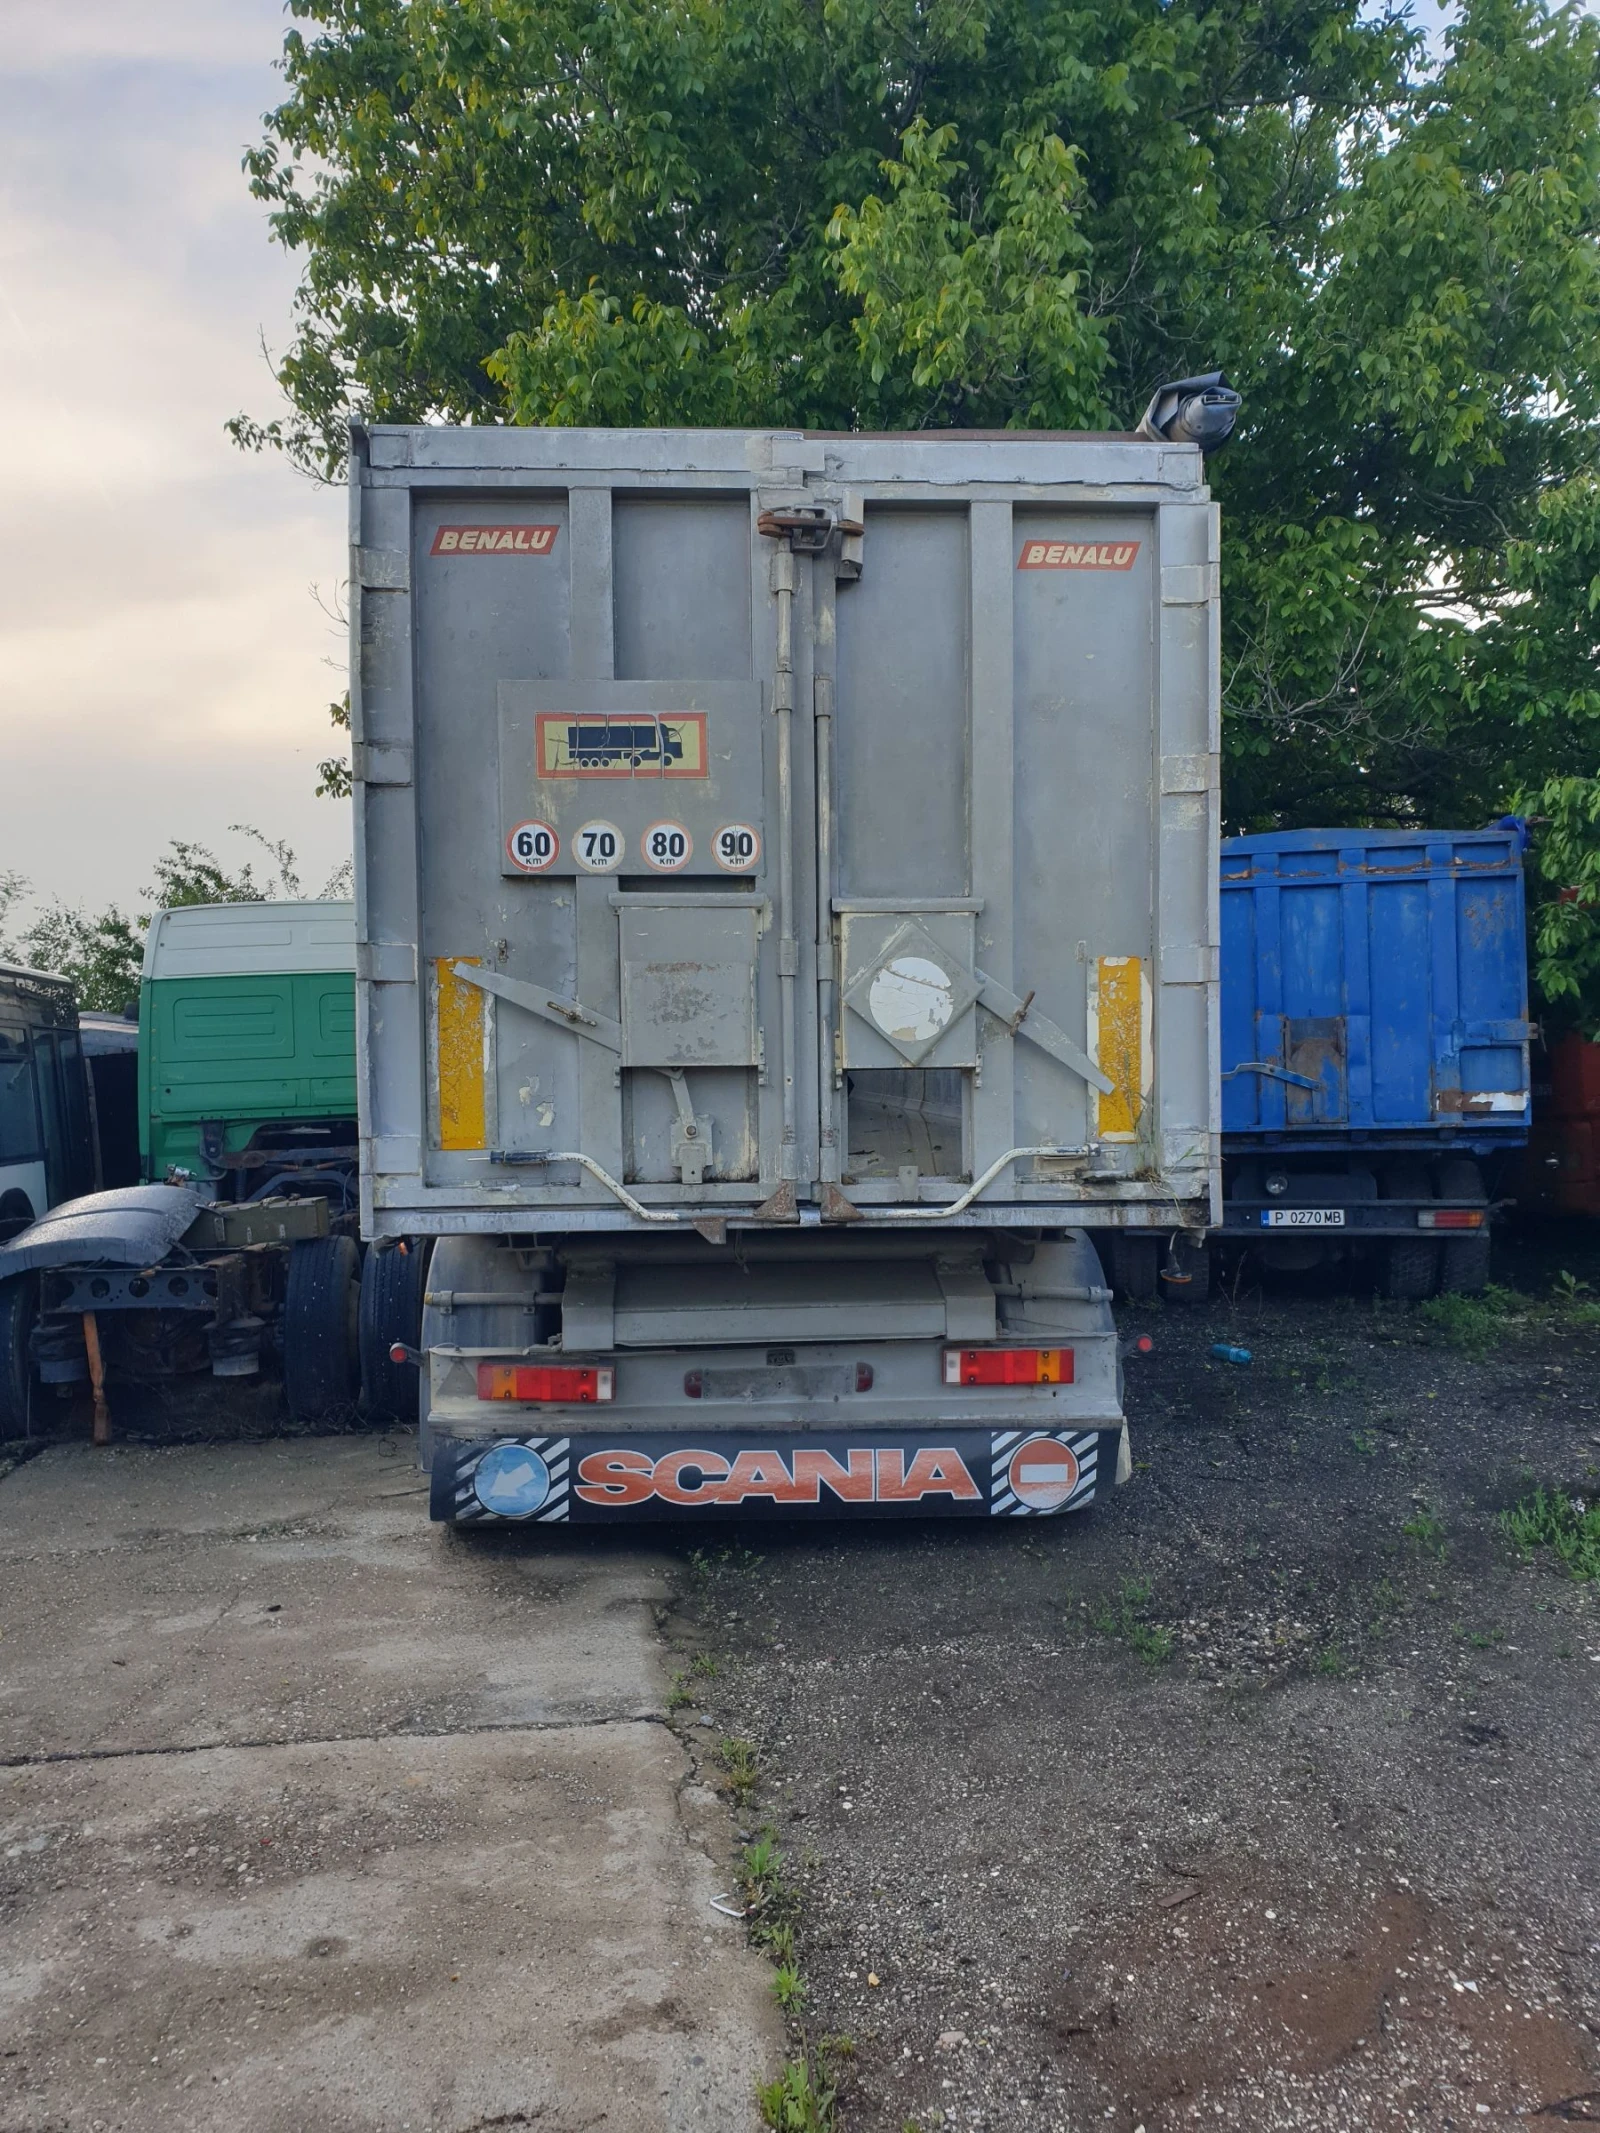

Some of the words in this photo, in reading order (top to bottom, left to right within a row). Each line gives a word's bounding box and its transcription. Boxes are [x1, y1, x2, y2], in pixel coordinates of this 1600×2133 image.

[439, 530, 551, 550] BENALU
[1026, 545, 1133, 565] BENALU
[517, 832, 551, 857] 60
[582, 832, 616, 858] 70
[652, 832, 685, 857] 80
[721, 832, 753, 857] 90
[1275, 1211, 1284, 1224] P
[573, 1447, 983, 1505] SCANIA
